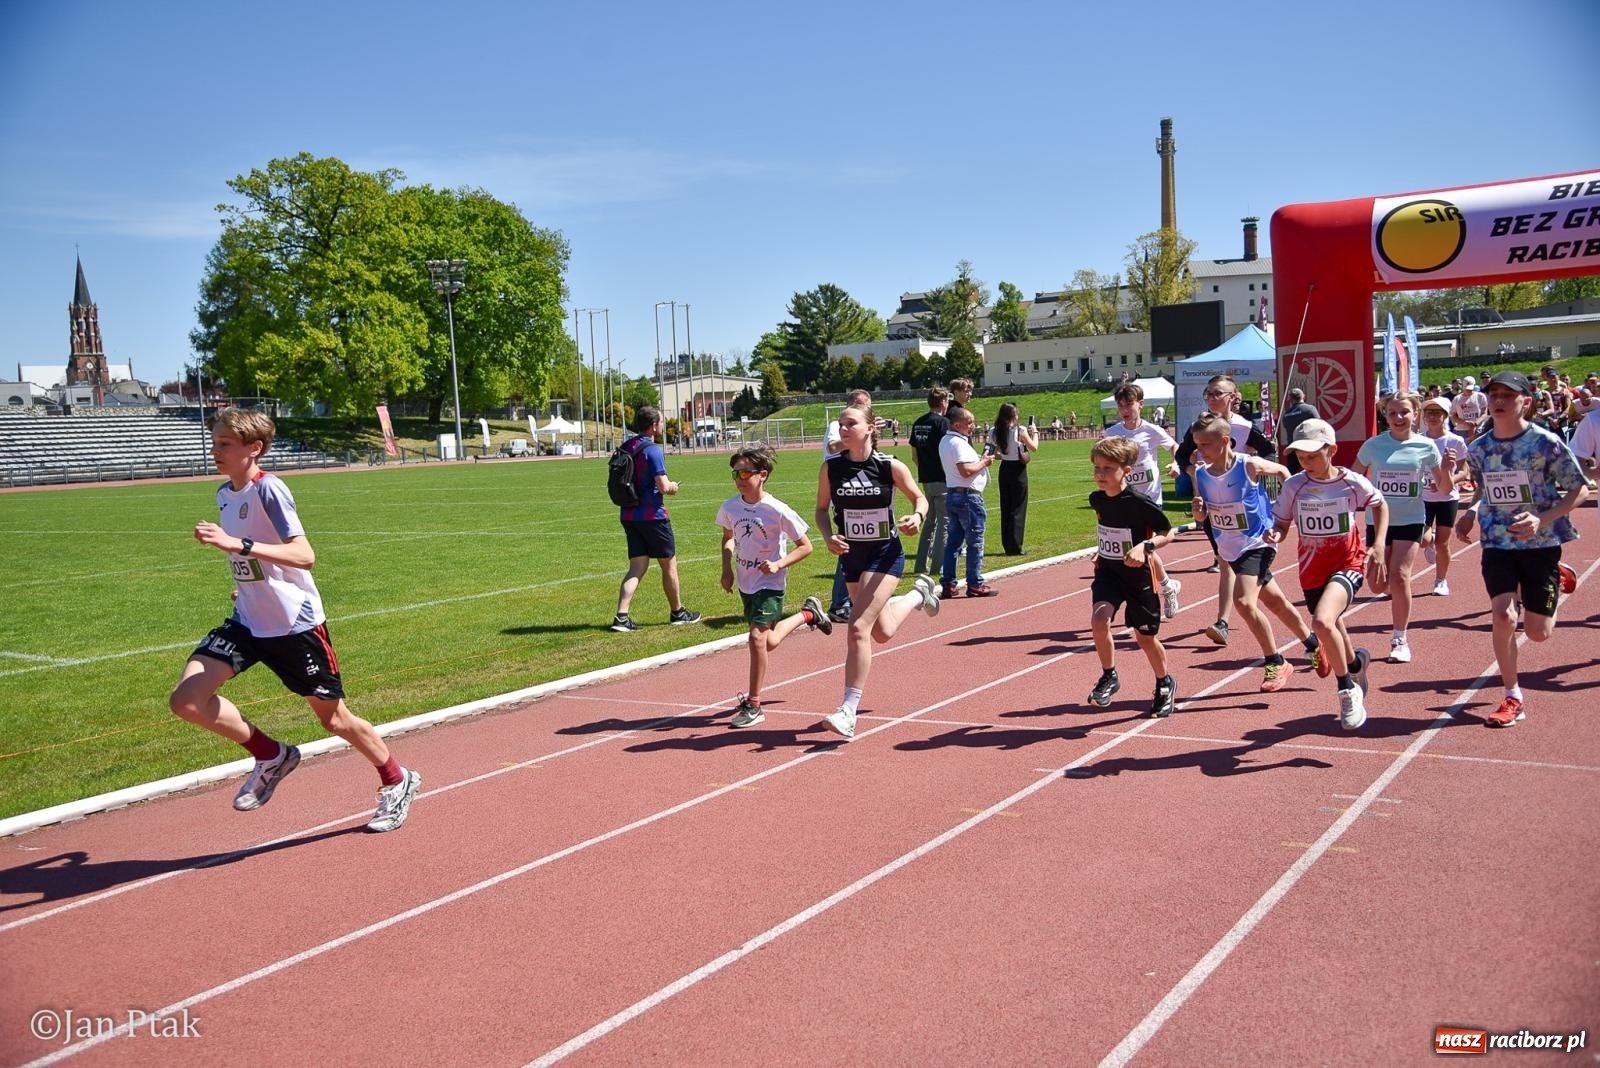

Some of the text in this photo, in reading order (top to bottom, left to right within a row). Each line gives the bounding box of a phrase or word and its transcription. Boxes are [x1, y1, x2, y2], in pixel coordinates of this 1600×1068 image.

[1490, 211, 1557, 237] BEZ
[836, 486, 881, 496] adidas
[1381, 481, 1408, 493] 006
[1493, 485, 1517, 499] 015
[1213, 514, 1234, 526] 012
[1306, 516, 1334, 530] 010
[852, 522, 875, 535] 016
[1099, 538, 1121, 554] 008
[230, 560, 250, 576] 05
